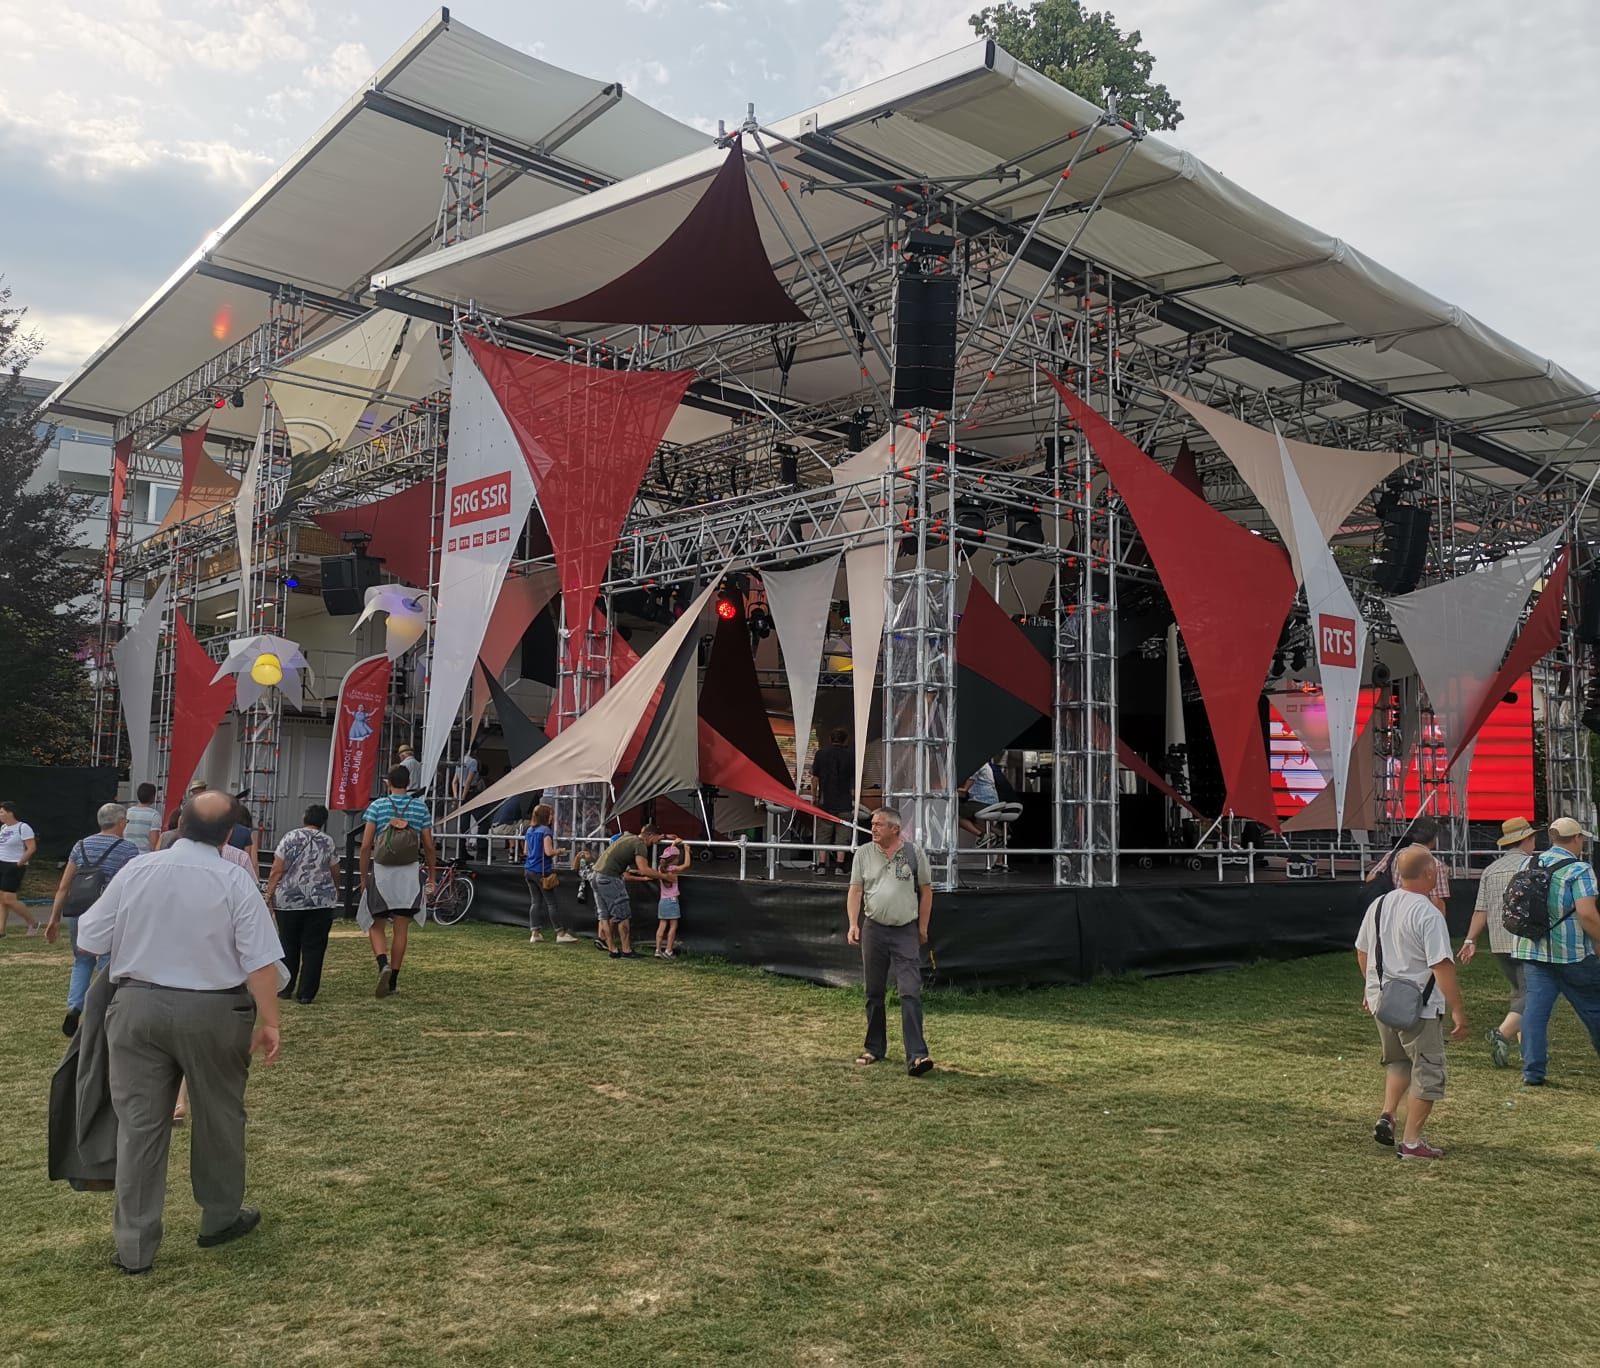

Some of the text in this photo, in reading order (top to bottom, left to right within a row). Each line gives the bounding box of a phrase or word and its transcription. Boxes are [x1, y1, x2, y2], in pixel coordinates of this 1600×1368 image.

[453, 483, 507, 516] SRG SSR
[1323, 627, 1352, 655] RTS
[337, 750, 352, 804] Le Passeport
[350, 751, 362, 784] de Julie
